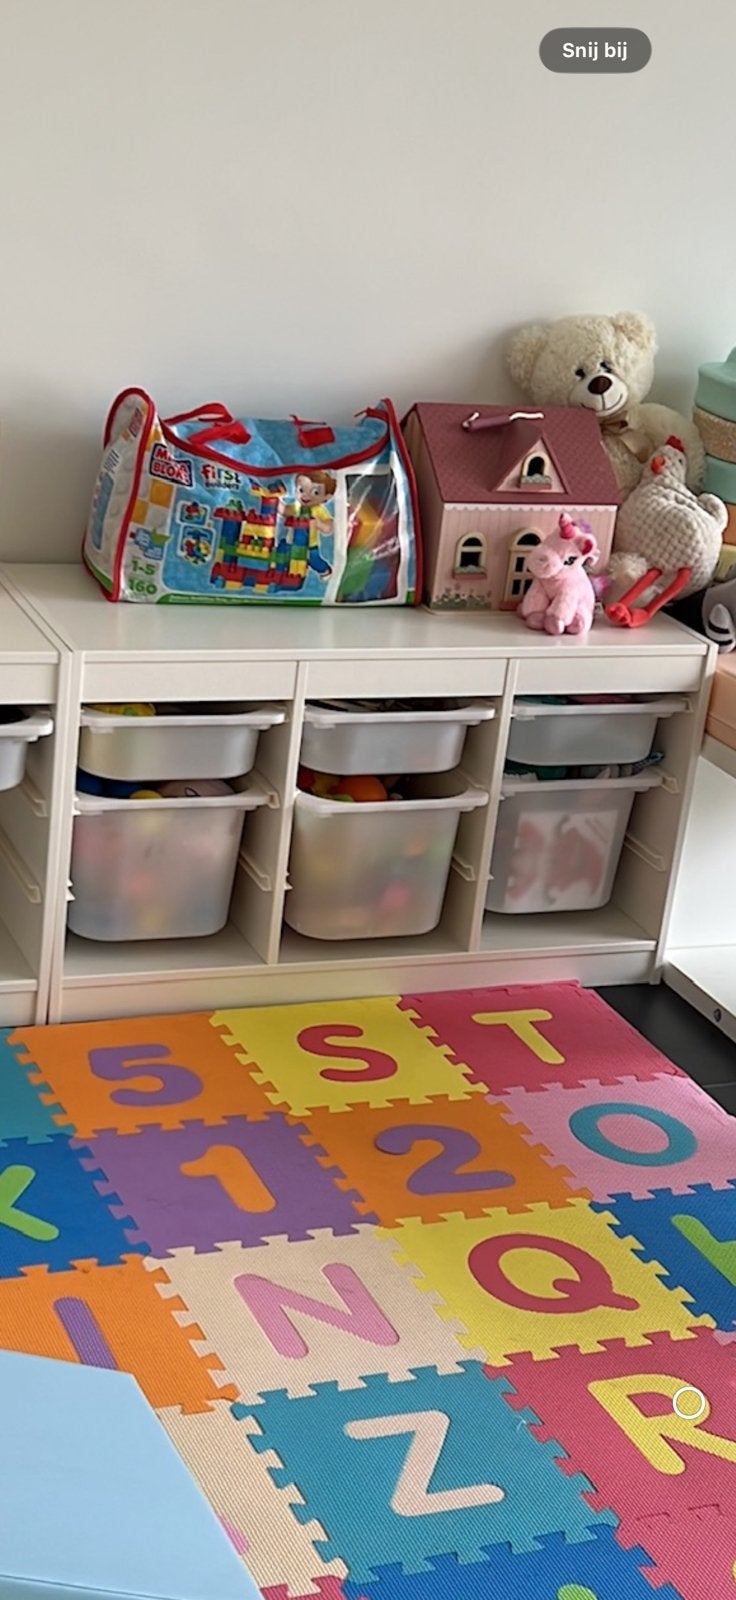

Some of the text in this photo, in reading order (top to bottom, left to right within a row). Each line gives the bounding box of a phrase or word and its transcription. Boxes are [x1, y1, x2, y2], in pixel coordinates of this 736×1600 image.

[131, 560, 156, 575] 1-5
[298, 1024, 398, 1082] S
[472, 1009, 566, 1065] T
[88, 1044, 204, 1106] 5
[179, 1144, 277, 1213] 1
[374, 1124, 516, 1195] 2
[468, 1233, 640, 1313] Q
[233, 1262, 400, 1359] N
[588, 1373, 736, 1475] R
[344, 1410, 505, 1516] Z
